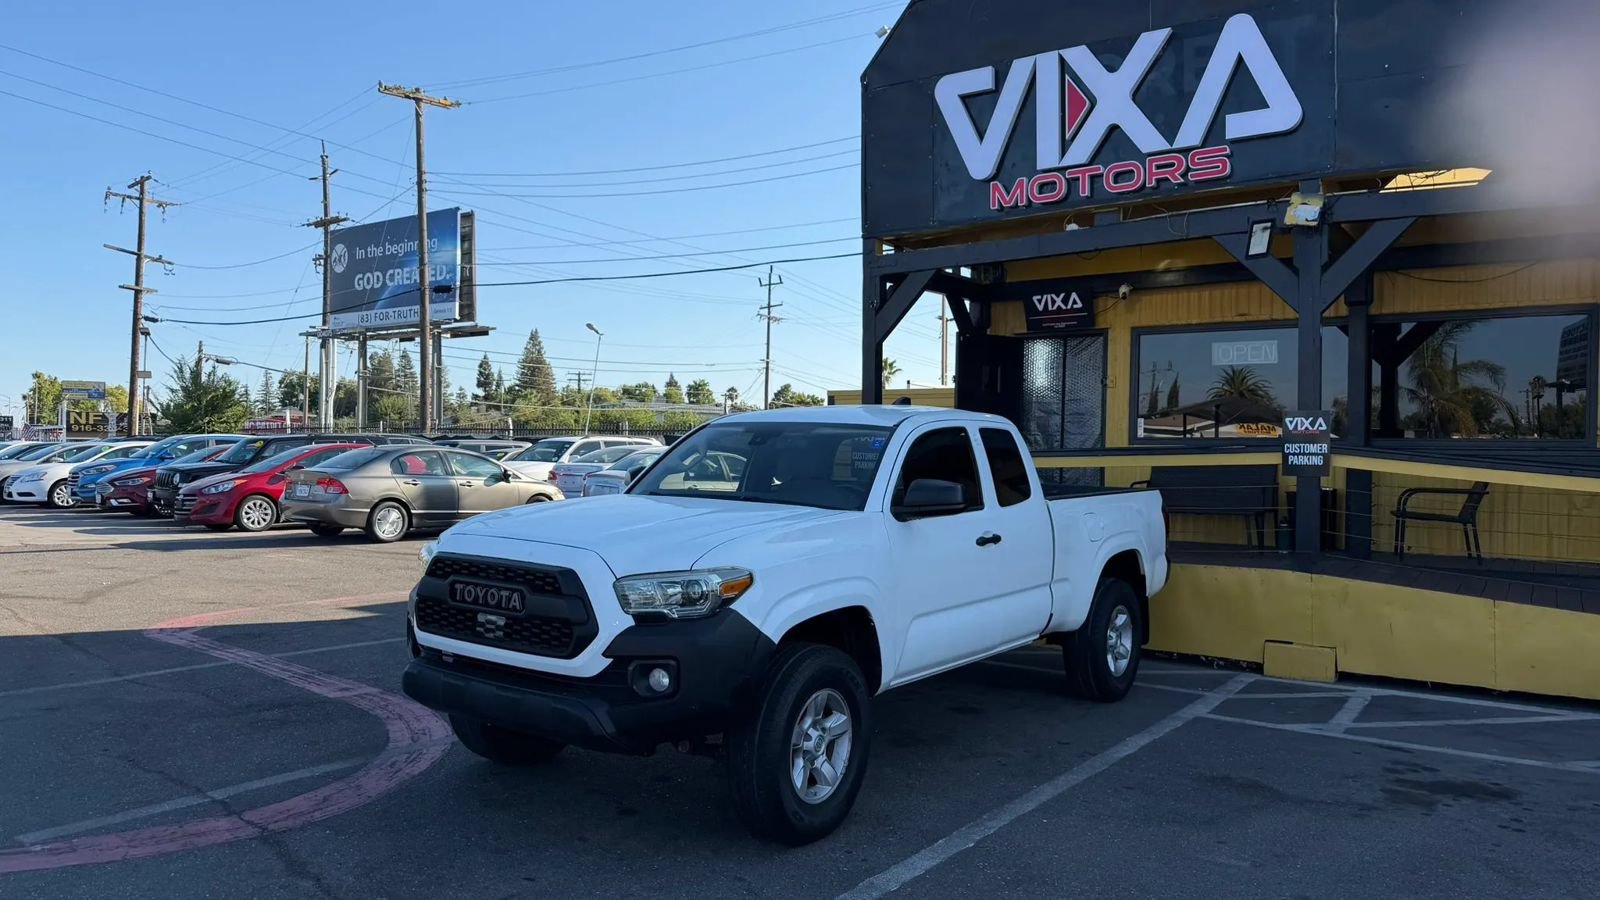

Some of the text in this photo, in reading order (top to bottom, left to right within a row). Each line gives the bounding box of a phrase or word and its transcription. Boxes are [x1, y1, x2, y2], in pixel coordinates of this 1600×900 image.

[934, 12, 1303, 181] VIXA
[989, 145, 1233, 209] MOTORS
[356, 247, 366, 260] In
[367, 244, 384, 257] the
[354, 263, 450, 291] GOD CREAED.
[1032, 291, 1083, 311] VIXA
[374, 307, 419, 322] FOR-TRUTH
[1219, 343, 1275, 362] OPEN
[1285, 417, 1327, 430] VIXA
[1284, 443, 1328, 453] CUSTOMER
[1288, 455, 1324, 465] PARKING
[454, 584, 523, 610] TOYOTA
